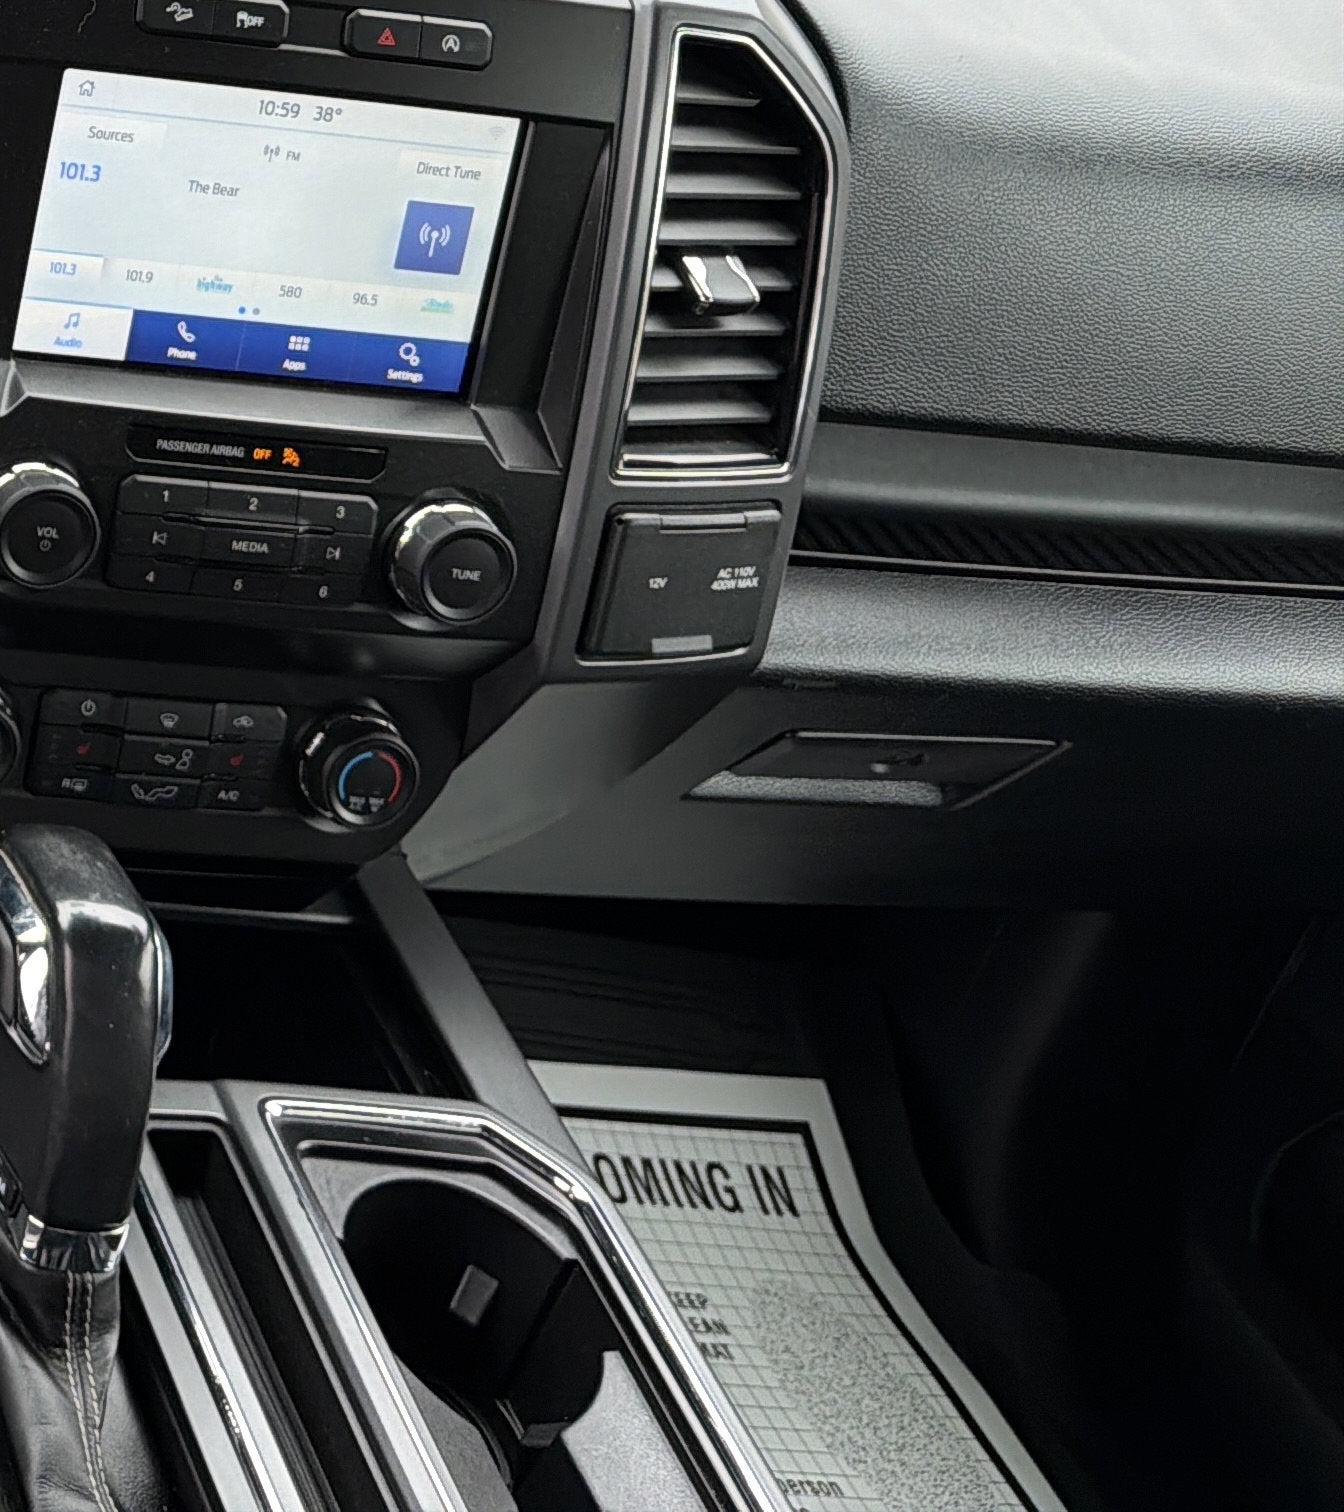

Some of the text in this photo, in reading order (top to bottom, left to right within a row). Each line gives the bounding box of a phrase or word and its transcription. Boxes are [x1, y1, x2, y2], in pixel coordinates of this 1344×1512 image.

[247, 16, 265, 28] OFF
[257, 98, 344, 124] 10:59 38°
[87, 125, 135, 144] Sources
[285, 149, 301, 163] FM
[59, 161, 103, 183] 101.3
[416, 161, 483, 182] Direct Tune
[188, 179, 241, 198] The Bear
[49, 261, 78, 277] 101.3
[125, 268, 155, 284] 101.9
[278, 284, 304, 300] 580
[352, 292, 380, 308] 96.5
[53, 336, 84, 350] Audio
[166, 346, 198, 362] Phone
[282, 358, 308, 373] Apps
[386, 368, 424, 384] Settings
[155, 438, 273, 461] PASSENGER AIRBAG OFF
[161, 489, 170, 504] 1
[248, 497, 259, 511] 2
[335, 505, 346, 520] 3
[36, 525, 60, 540] VOL
[231, 538, 270, 555] MEDIA
[144, 570, 156, 584] 4
[450, 567, 483, 583] TUNE
[716, 565, 757, 579] AC 110V
[232, 577, 243, 592] 5
[648, 576, 669, 590] 12V
[737, 576, 760, 589] MAX
[318, 585, 329, 599] 6
[216, 789, 240, 803] A/C
[745, 1164, 801, 1218] IN
